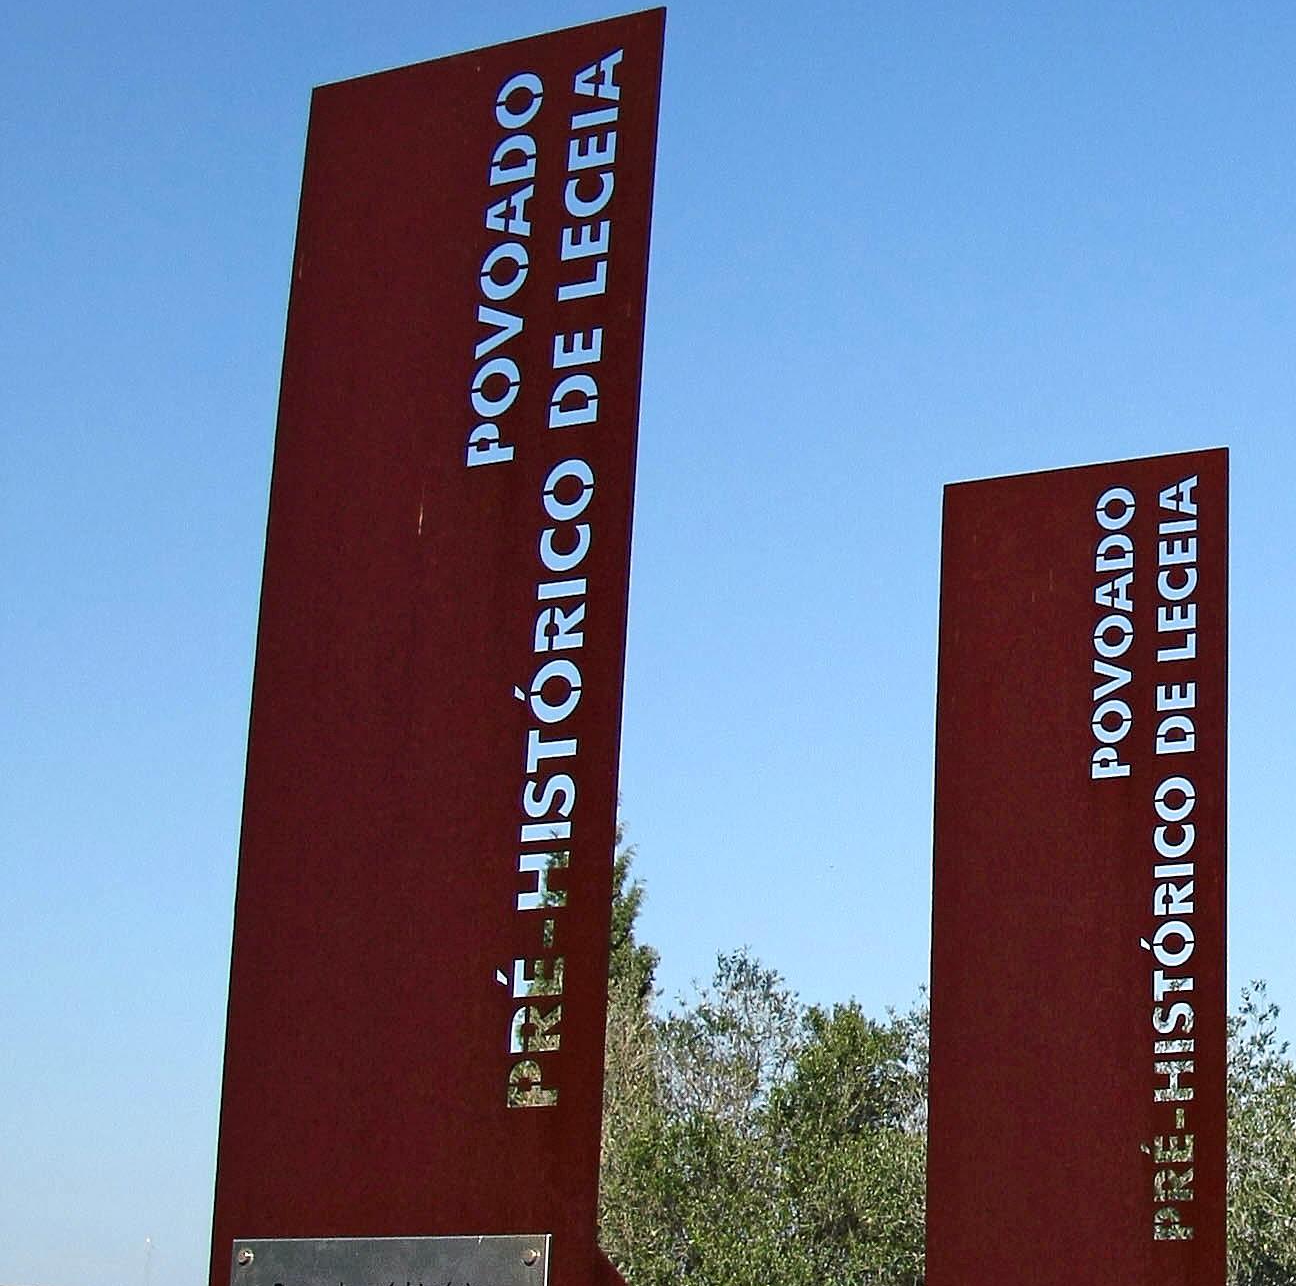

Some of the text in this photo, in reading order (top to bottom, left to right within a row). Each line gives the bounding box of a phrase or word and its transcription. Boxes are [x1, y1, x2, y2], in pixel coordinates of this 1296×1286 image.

[466, 71, 544, 467] POVOADO
[496, 48, 625, 1109] PRÉ-HISTÓRICO DE LECEIA
[1091, 487, 1136, 780] POVOADO
[1140, 474, 1199, 1241] PRÉ-HISTÓRICO DE LECEIA
